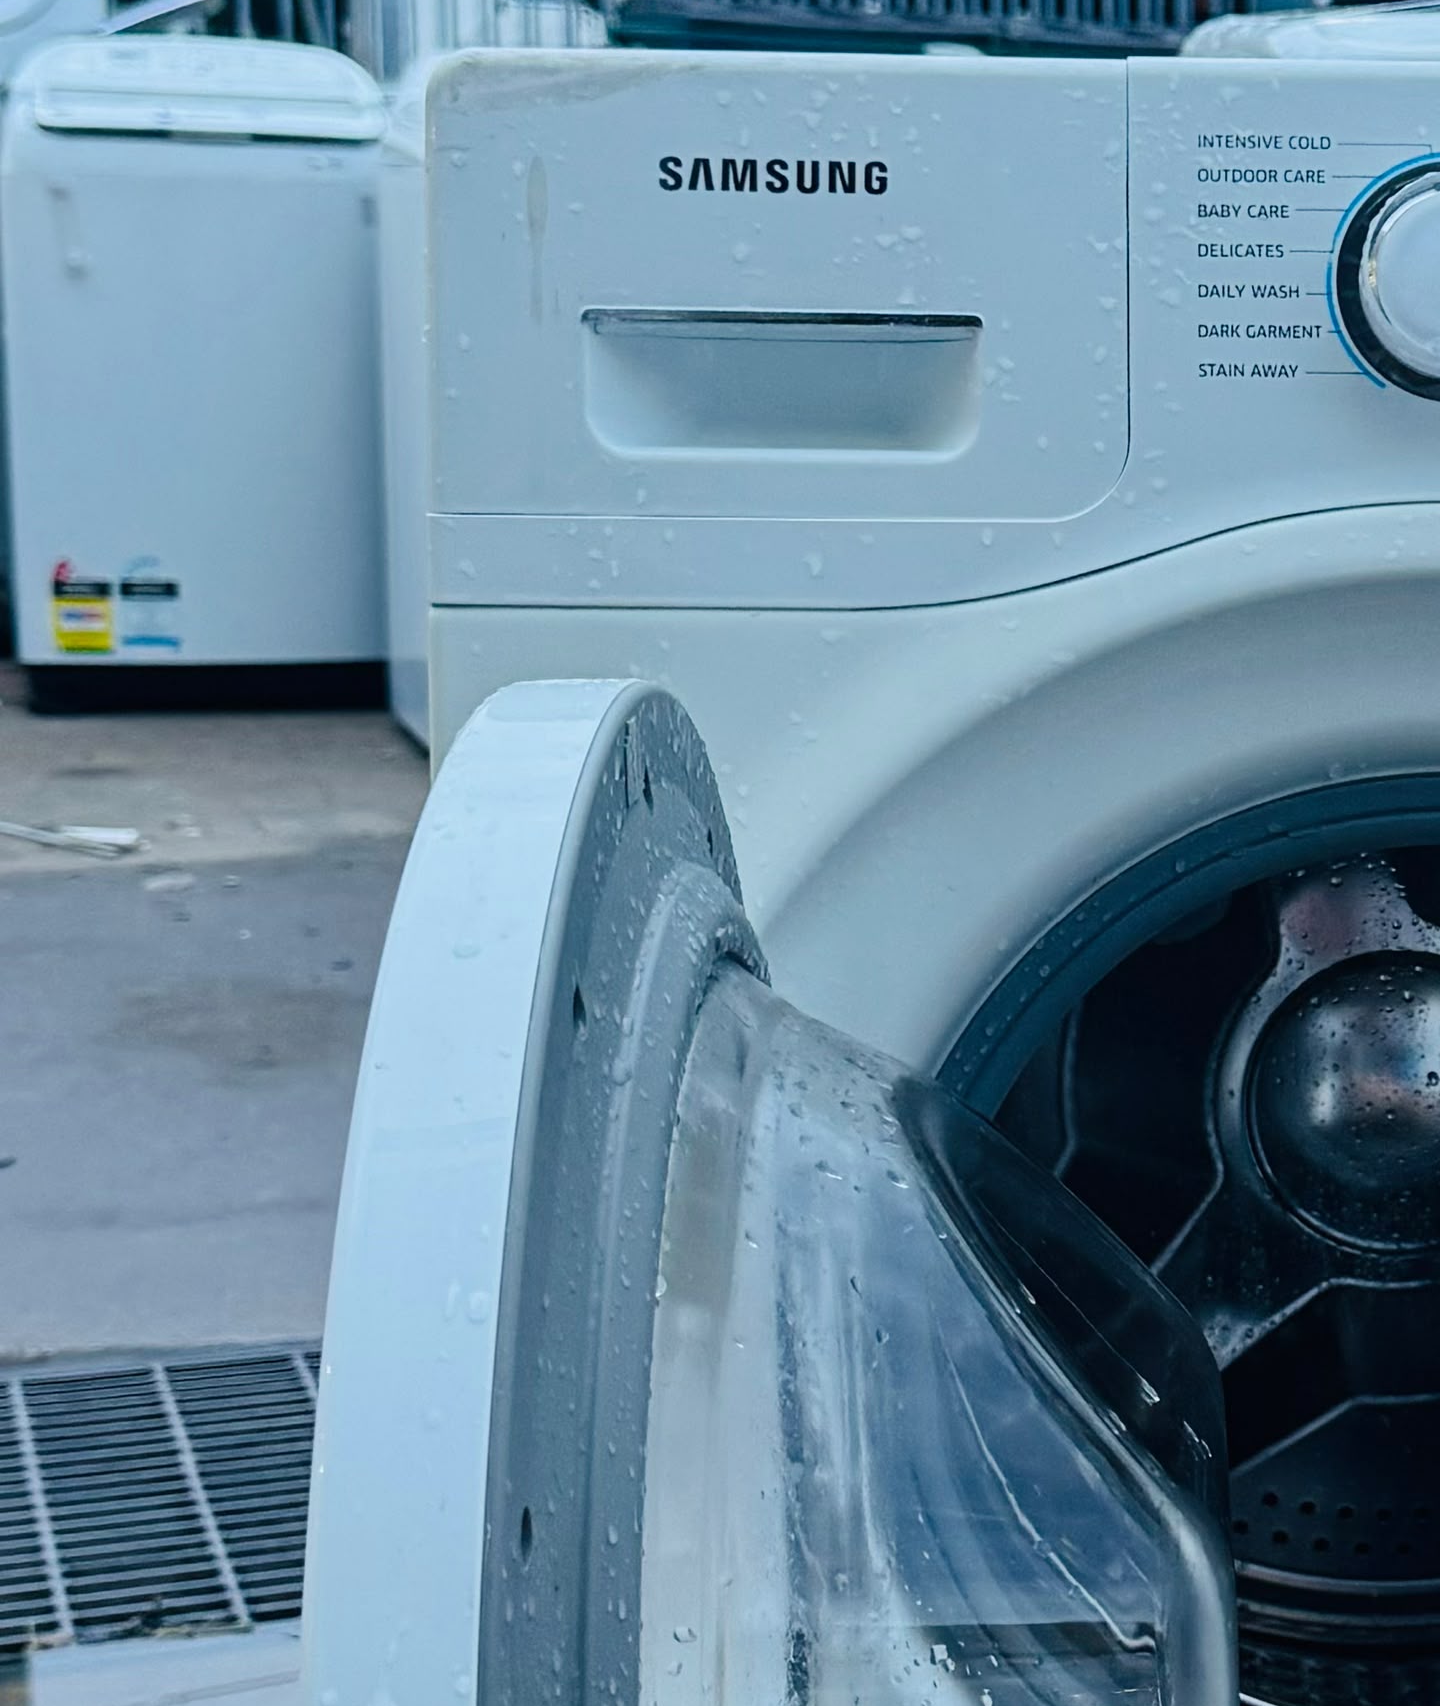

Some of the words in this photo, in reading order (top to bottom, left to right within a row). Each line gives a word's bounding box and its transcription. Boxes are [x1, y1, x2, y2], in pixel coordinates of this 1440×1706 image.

[1198, 135, 1283, 150] INTENSIVE
[1288, 136, 1331, 150] COLD
[658, 156, 889, 195] SAMSUNG
[1198, 169, 1280, 184] OUTDOOR
[1285, 170, 1326, 184] CARE
[1198, 204, 1243, 218] BABY
[1248, 204, 1290, 218] CARE
[1198, 244, 1284, 258] DELICATES
[1198, 285, 1245, 299] DAILY
[1251, 285, 1300, 299] WASH
[1198, 325, 1241, 339] DARK
[1245, 325, 1322, 340] GARMENT
[1199, 364, 1247, 378] STAIN
[1252, 364, 1299, 379] AWAY
